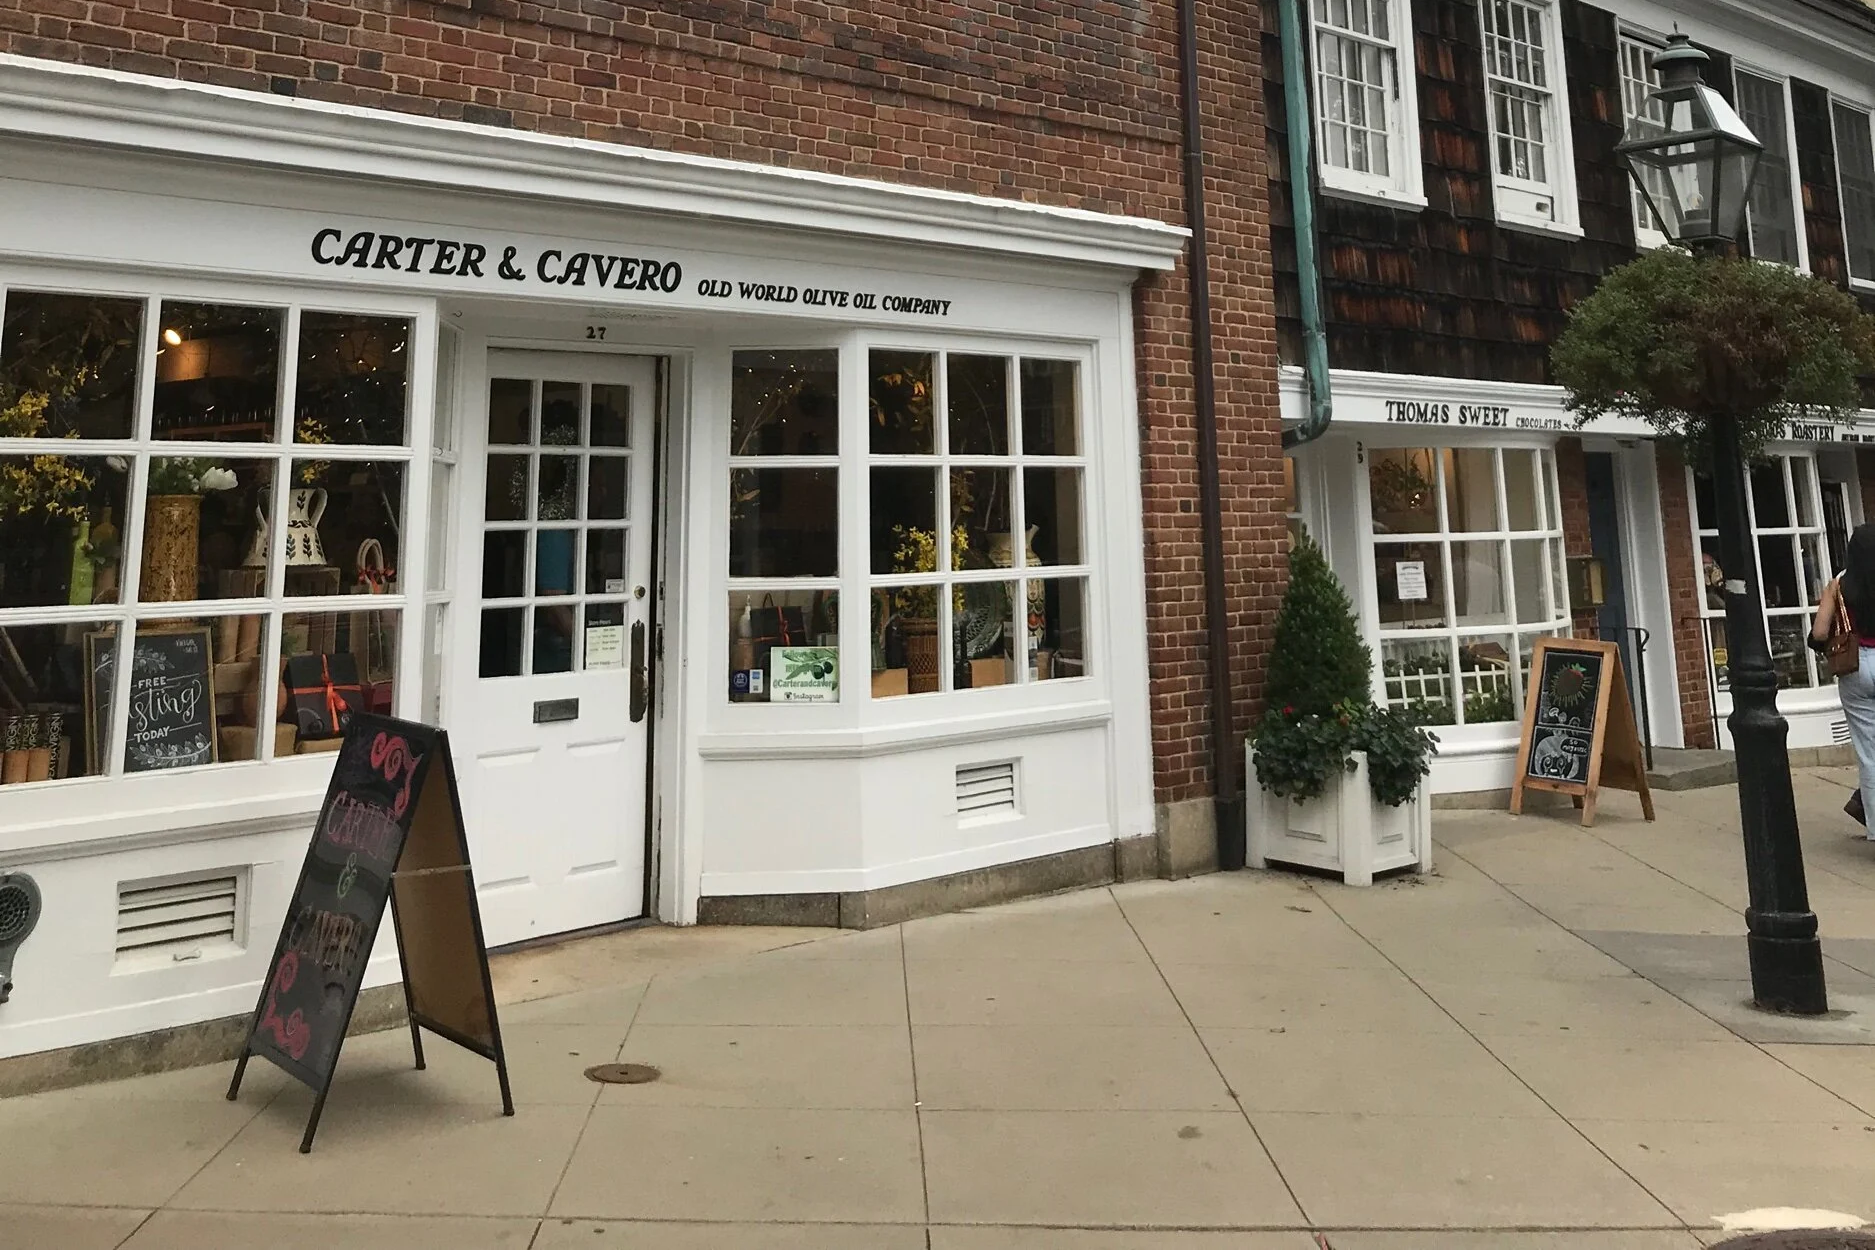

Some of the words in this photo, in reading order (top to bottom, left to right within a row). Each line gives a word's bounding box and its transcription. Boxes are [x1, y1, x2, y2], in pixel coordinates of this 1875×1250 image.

[311, 228, 487, 277] CARTER
[497, 246, 526, 281] &
[537, 250, 682, 293] CAVERO
[697, 279, 733, 298] OLD
[738, 282, 798, 303] WORLD
[802, 288, 849, 307] OLIVE
[853, 293, 877, 310] OIL
[882, 295, 952, 316] COMPANY
[586, 326, 607, 340] 27
[1385, 400, 1449, 424] THOMAS
[1458, 405, 1510, 427] SWEET
[1515, 417, 1562, 430] CHOCOLATES
[1791, 421, 1835, 441] ROASTERY
[138, 676, 167, 689] FREE
[134, 726, 170, 743] TODAY
